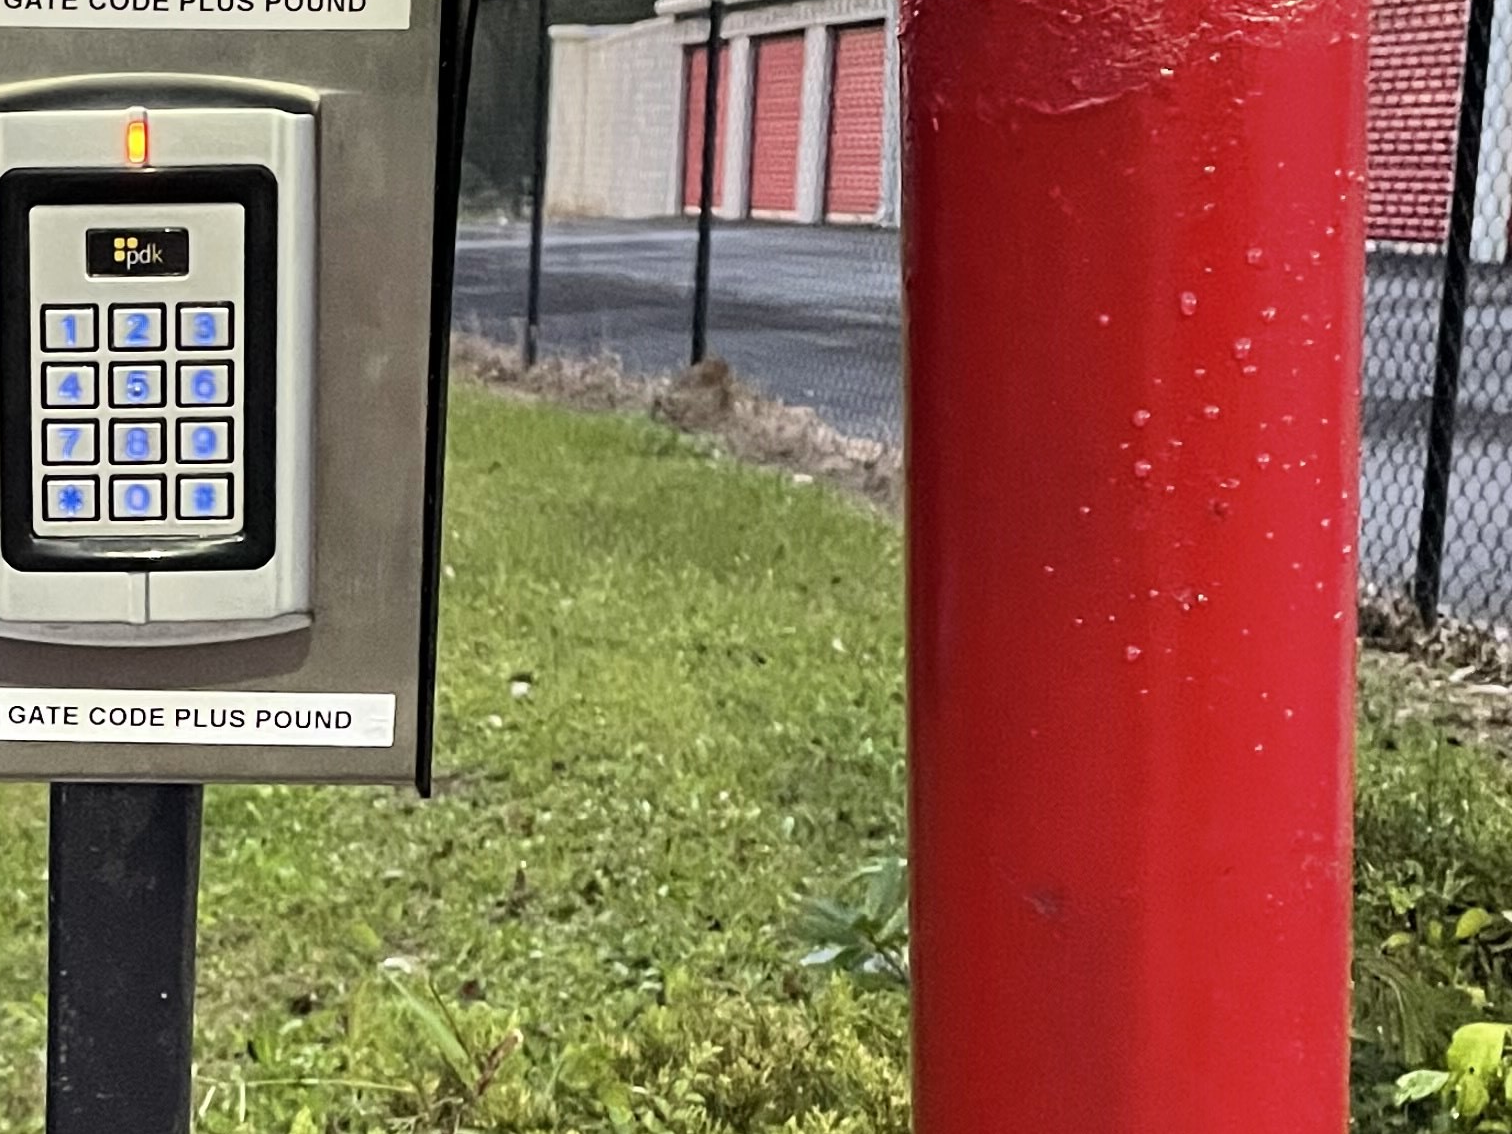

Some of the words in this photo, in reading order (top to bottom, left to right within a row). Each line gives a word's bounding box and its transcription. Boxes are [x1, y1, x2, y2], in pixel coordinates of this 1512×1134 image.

[126, 242, 164, 270] pdk
[61, 314, 77, 345] 1
[125, 312, 150, 345] 2
[192, 312, 217, 345] 3
[58, 372, 83, 402] 4
[126, 370, 150, 402] 5
[191, 370, 217, 402] 6
[59, 427, 82, 460] 7
[125, 426, 150, 460] 8
[191, 426, 217, 460] 9
[124, 483, 152, 515] 0
[8, 705, 79, 726] GATE
[89, 706, 165, 727] CODE
[175, 708, 246, 728] PLUS
[255, 709, 352, 729] POUND
